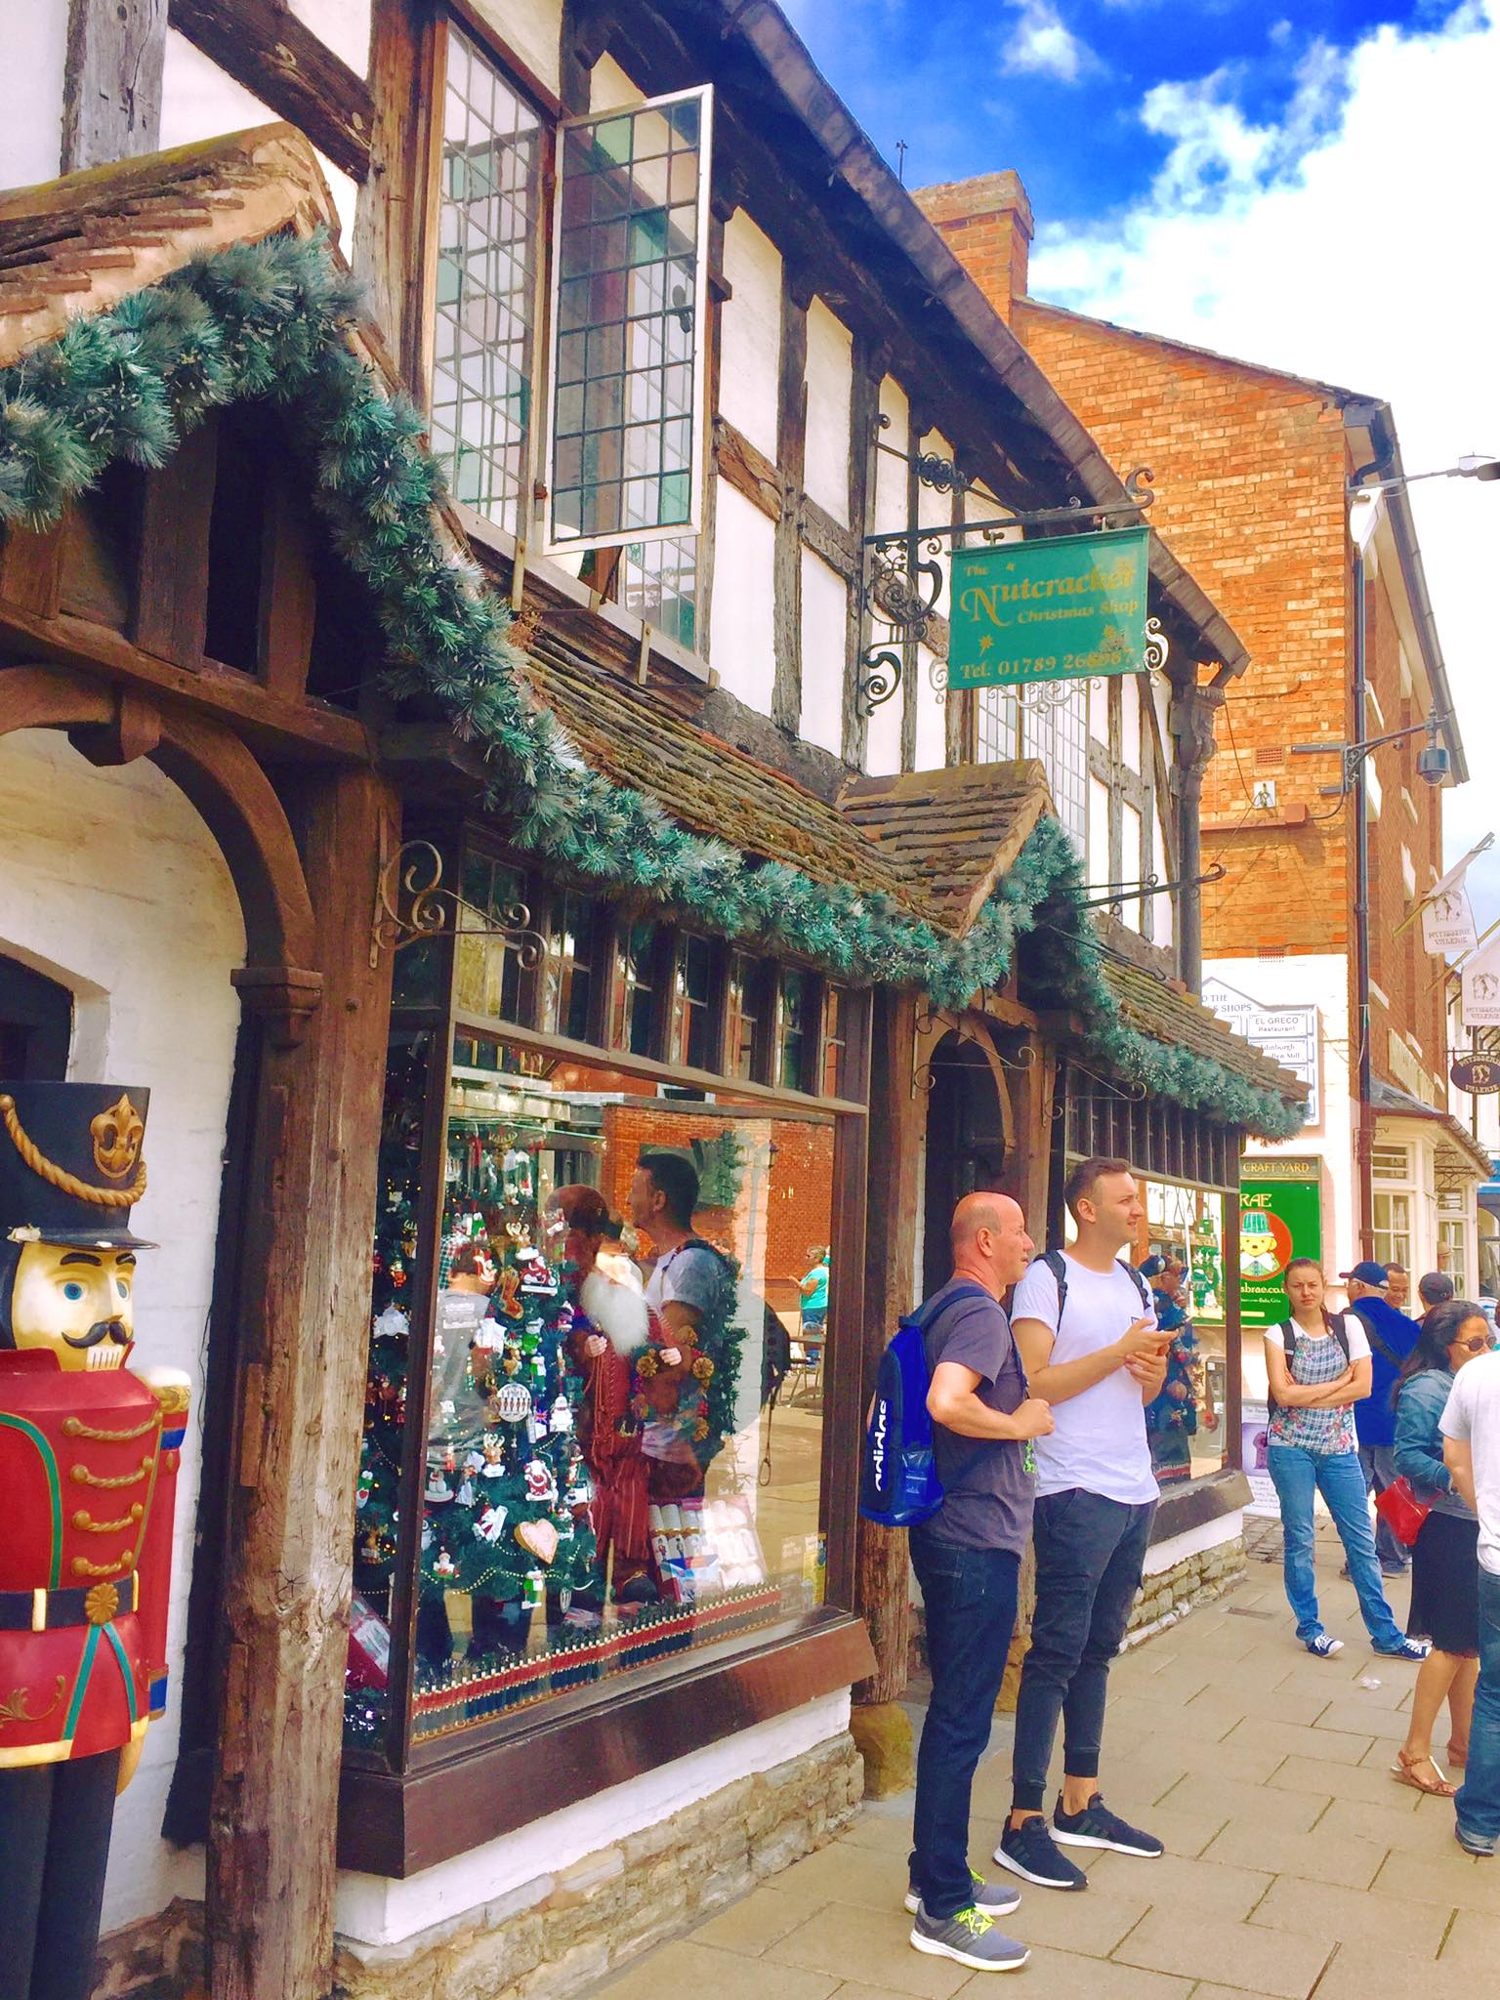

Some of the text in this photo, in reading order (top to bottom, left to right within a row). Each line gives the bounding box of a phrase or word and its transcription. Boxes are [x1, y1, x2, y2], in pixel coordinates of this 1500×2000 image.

[964, 565, 988, 577] The
[960, 567, 1137, 627] Nutcracker
[1017, 600, 1138, 625] Christmas Shop
[997, 655, 1057, 676] 01789
[1209, 994, 1228, 1002] THE
[1221, 1003, 1252, 1012] SHOPS
[1267, 1016, 1299, 1025] GRECO
[1243, 1161, 1310, 1173] CRAFT YARD
[873, 1399, 887, 1492] adidas
